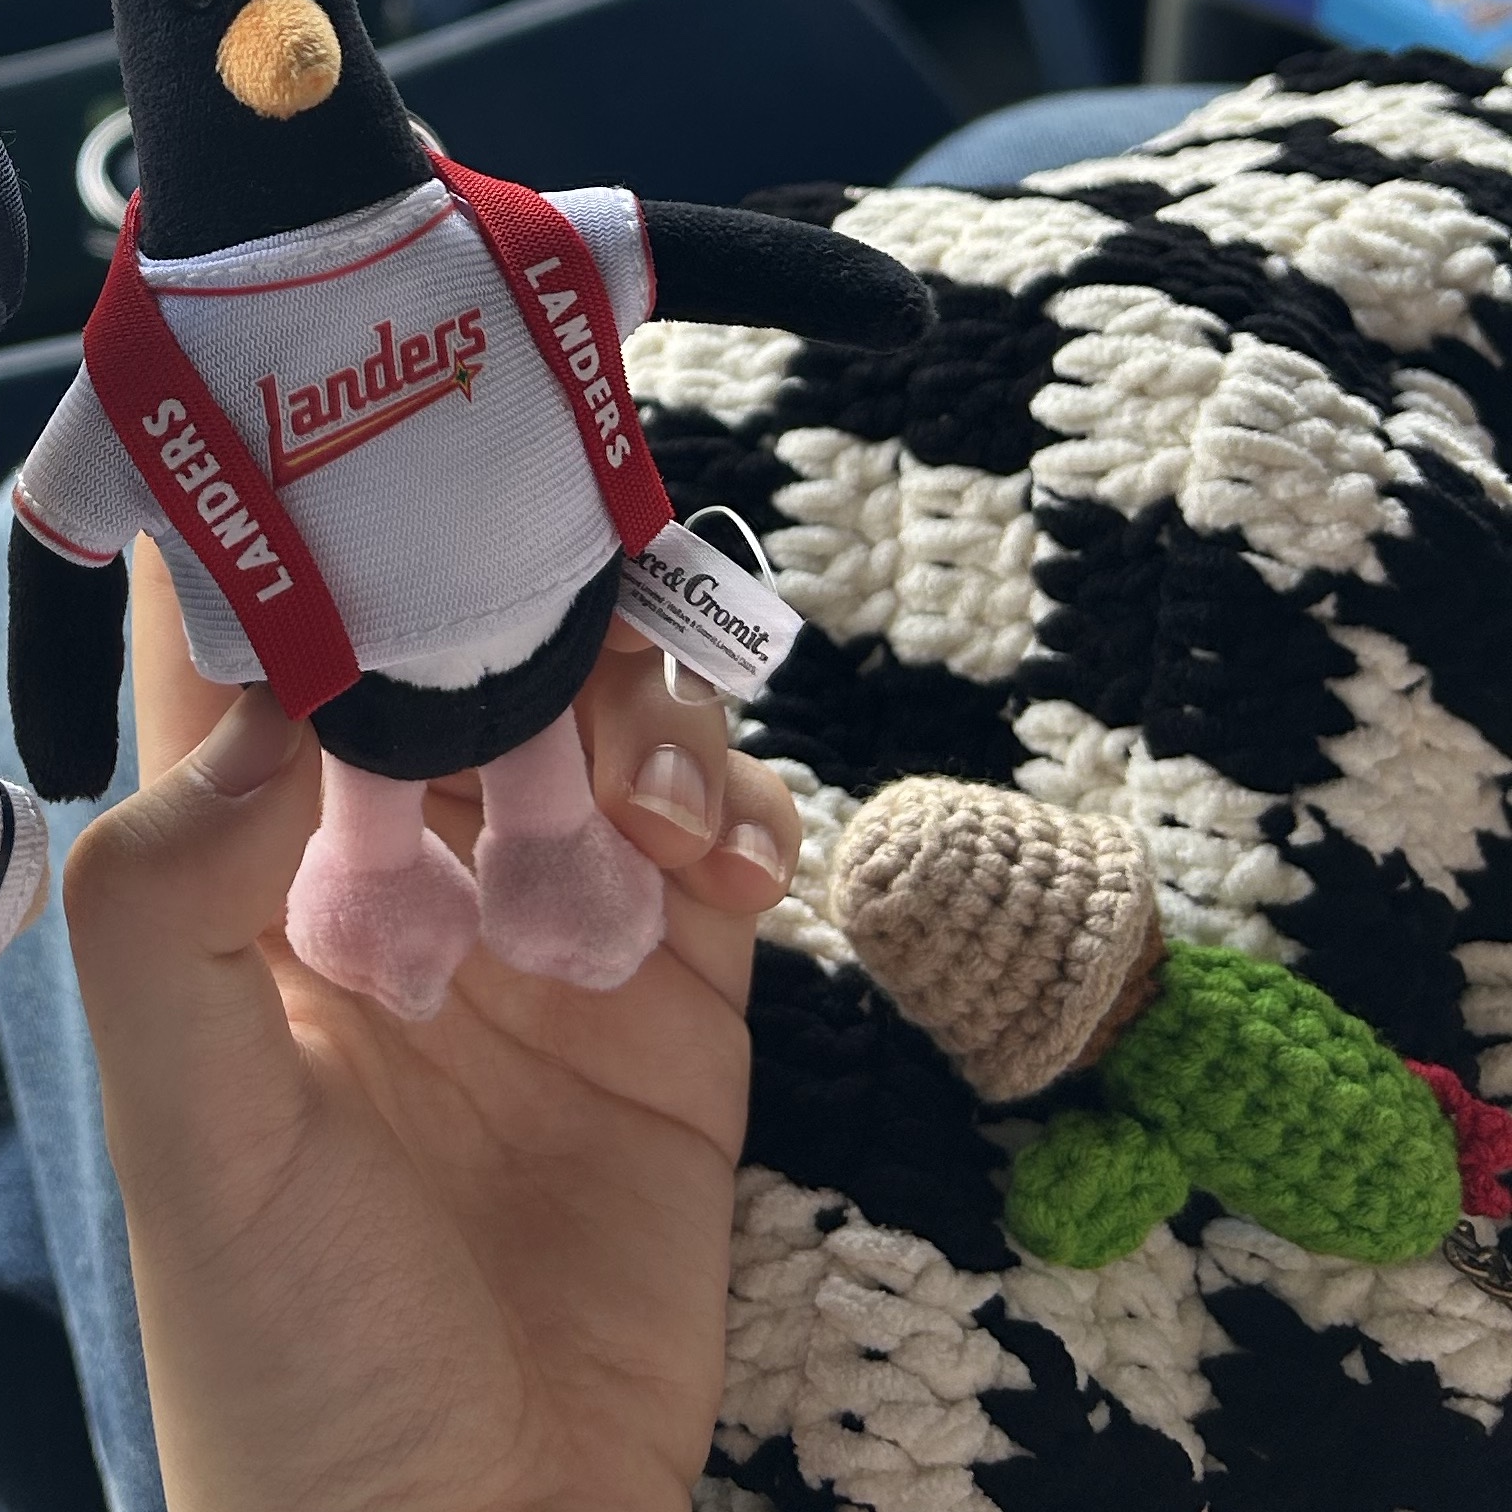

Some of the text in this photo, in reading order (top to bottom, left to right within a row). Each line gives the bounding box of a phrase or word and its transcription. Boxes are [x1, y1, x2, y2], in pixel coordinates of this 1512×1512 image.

[255, 307, 486, 488] Landers
[524, 256, 631, 469] LANDERS
[142, 398, 294, 603] LANDERS
